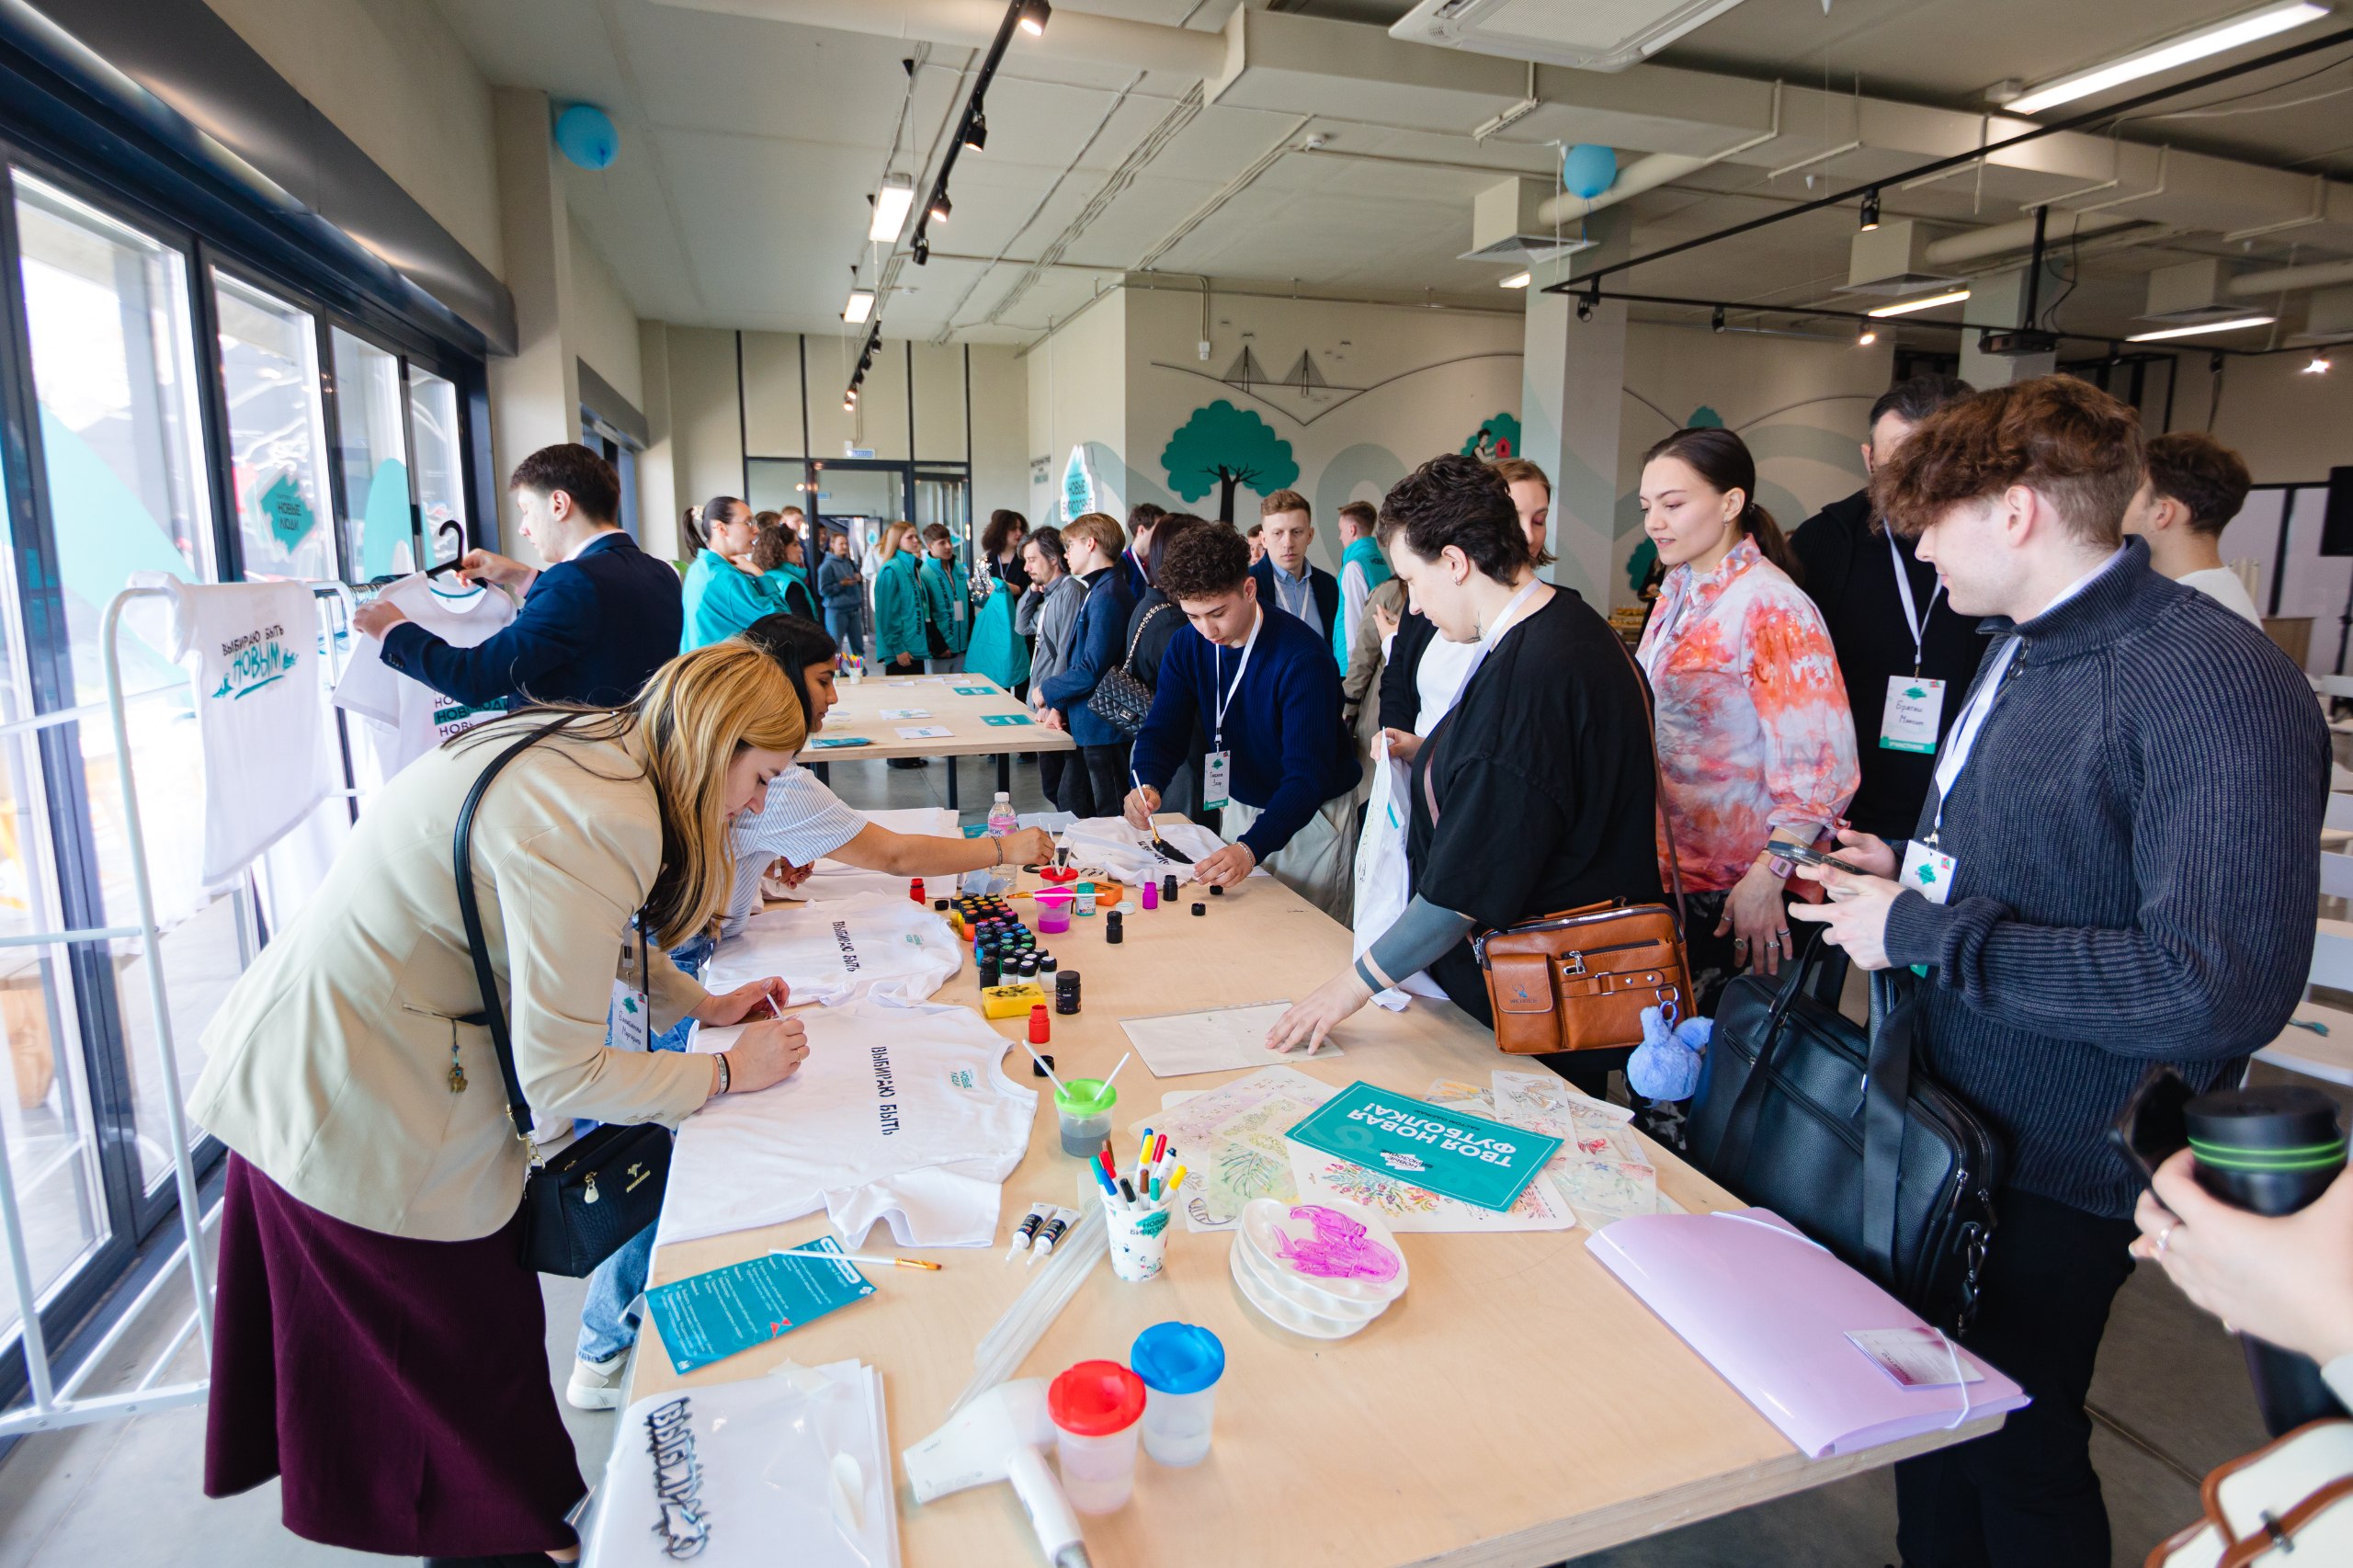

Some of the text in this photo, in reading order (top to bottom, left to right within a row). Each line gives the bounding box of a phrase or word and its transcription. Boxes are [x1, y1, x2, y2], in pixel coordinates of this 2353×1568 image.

[222, 624, 285, 656] ВЫБИРАЮ БЫТЬ
[233, 642, 280, 685] НОВЫМ
[832, 921, 860, 972] ВЫБИРАЮ БЫТЬ
[870, 1046, 900, 1135] ВЫБИРАЮ БЫТЬ
[1347, 1108, 1512, 1168] ТВОЯ НОВАЯ
[1363, 1102, 1517, 1153] ФУТБОЛКА!
[1449, 1119, 1481, 1131] КАСТОМ
[1380, 1149, 1434, 1169] БИРЮЗОВЫЕ
[1387, 1156, 1418, 1168] НОВЫЕ
